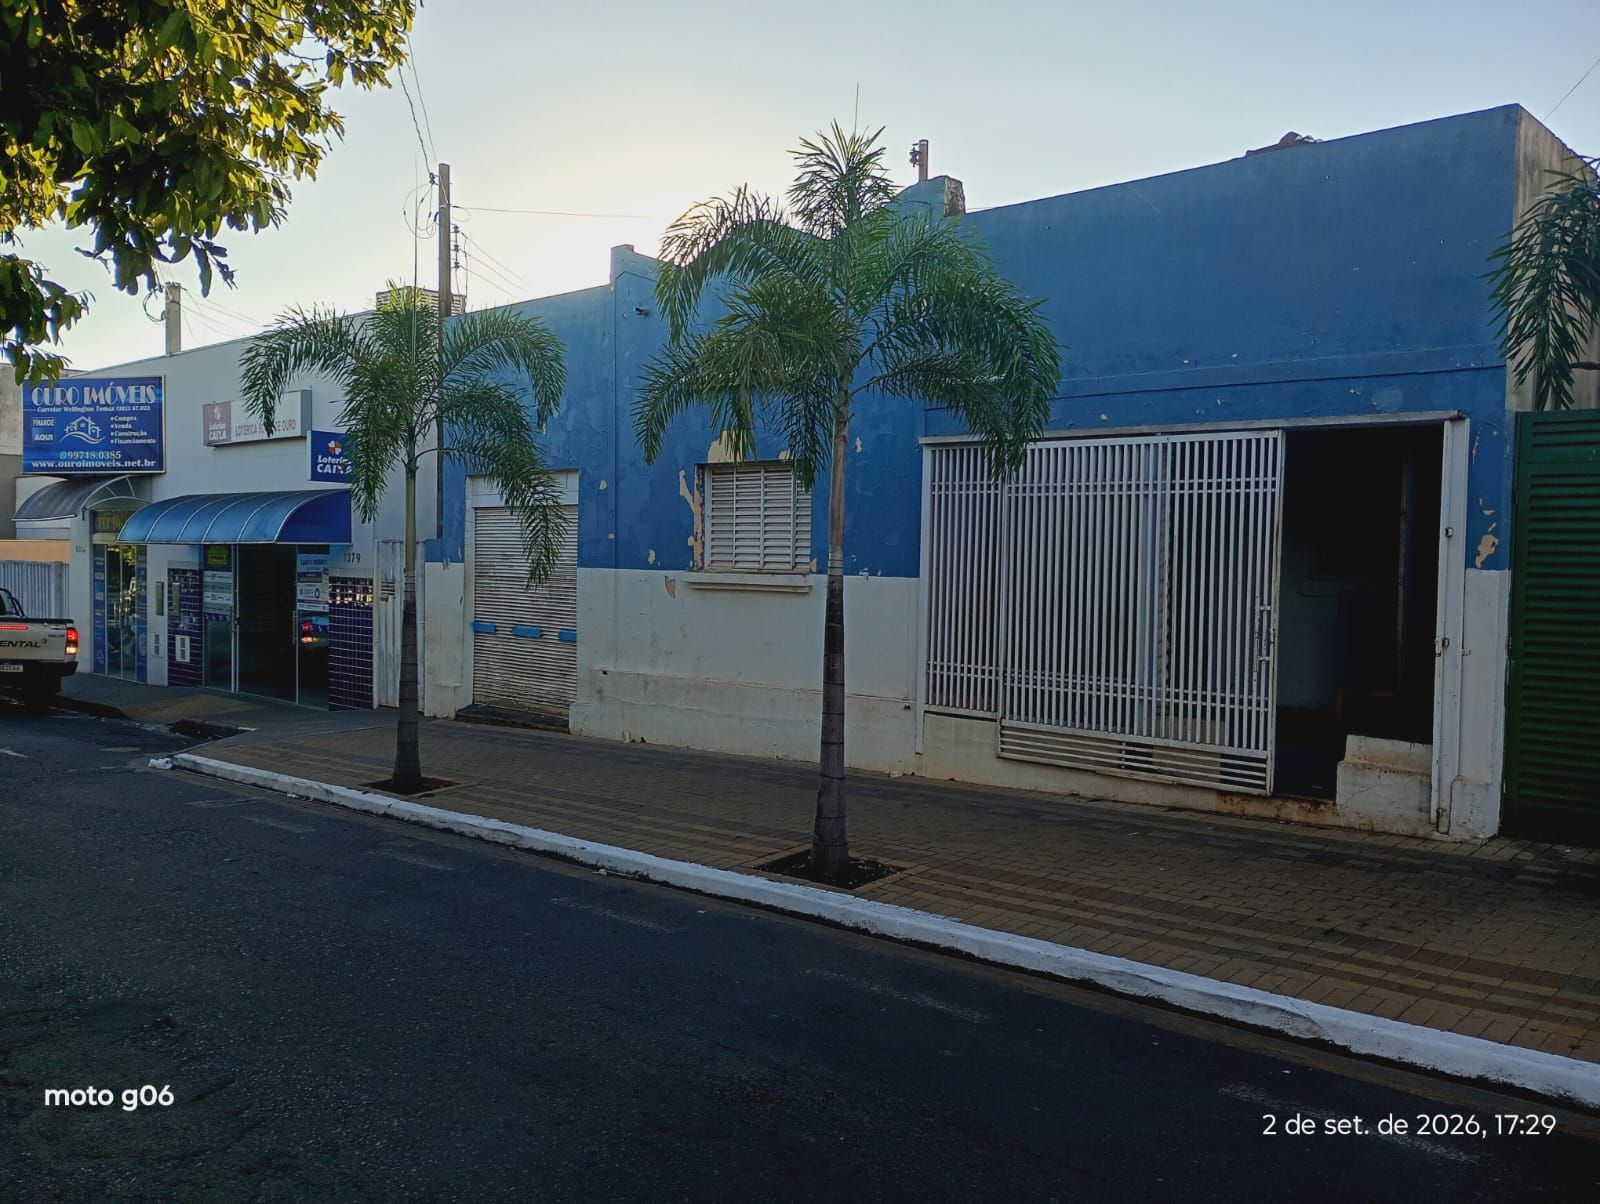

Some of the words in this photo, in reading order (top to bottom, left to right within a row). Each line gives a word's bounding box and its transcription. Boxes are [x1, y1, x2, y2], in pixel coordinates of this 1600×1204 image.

[32, 386, 80, 406] OURO
[84, 382, 156, 405] IMÓVEIS
[282, 418, 296, 432] OURO
[34, 433, 53, 441] AQUI
[208, 430, 227, 440] CAIXA
[67, 451, 121, 460] 99718.0385
[32, 459, 156, 468] www.ouroimoveis.net.br
